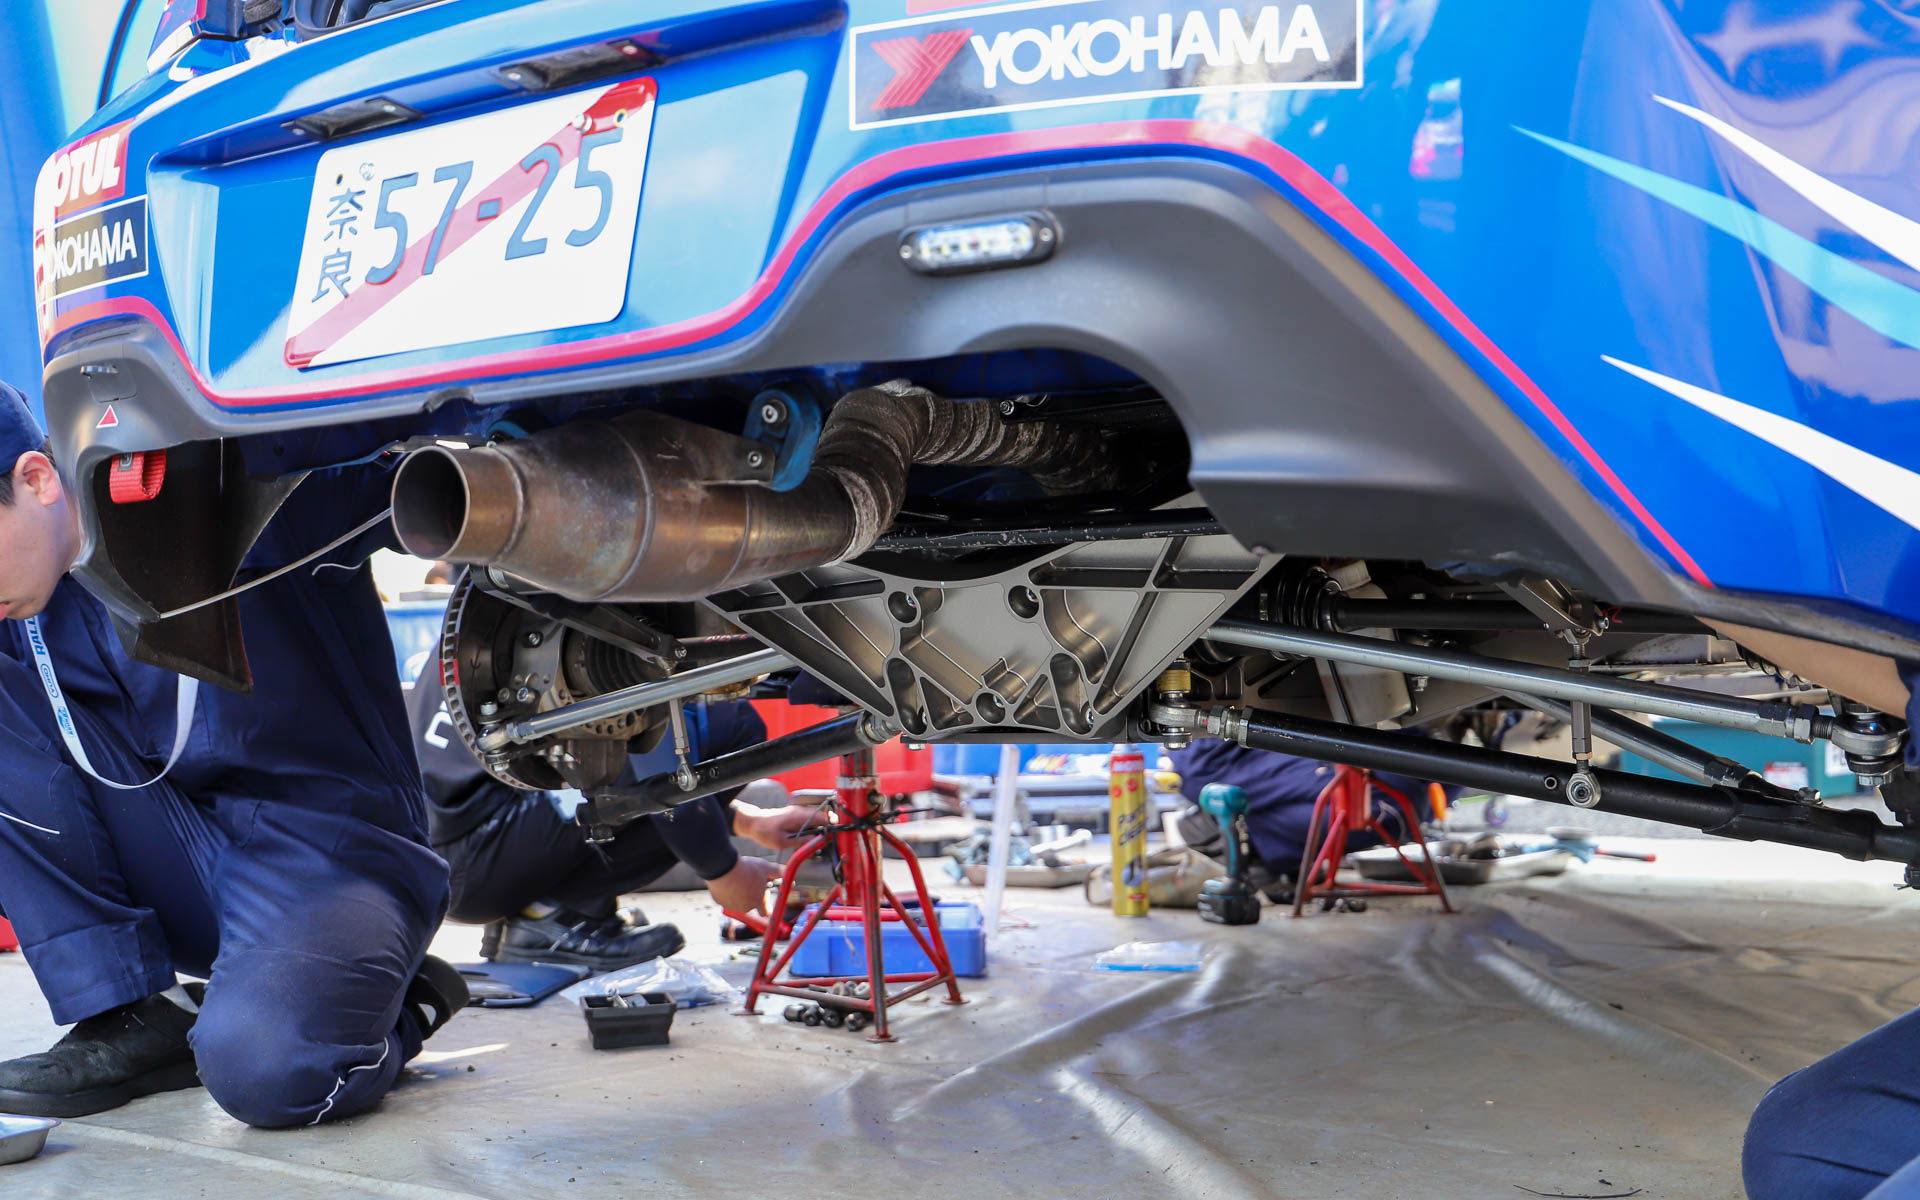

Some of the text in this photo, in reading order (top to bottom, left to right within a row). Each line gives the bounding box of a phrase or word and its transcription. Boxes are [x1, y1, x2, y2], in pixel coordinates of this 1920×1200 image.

[971, 5, 1330, 88] YOKOHAMA
[53, 133, 121, 208] OTUL
[365, 127, 624, 286] 57-25
[46, 218, 138, 283] OKOHAMA
[312, 188, 366, 303] 奈良
[27, 616, 46, 656] RALL
